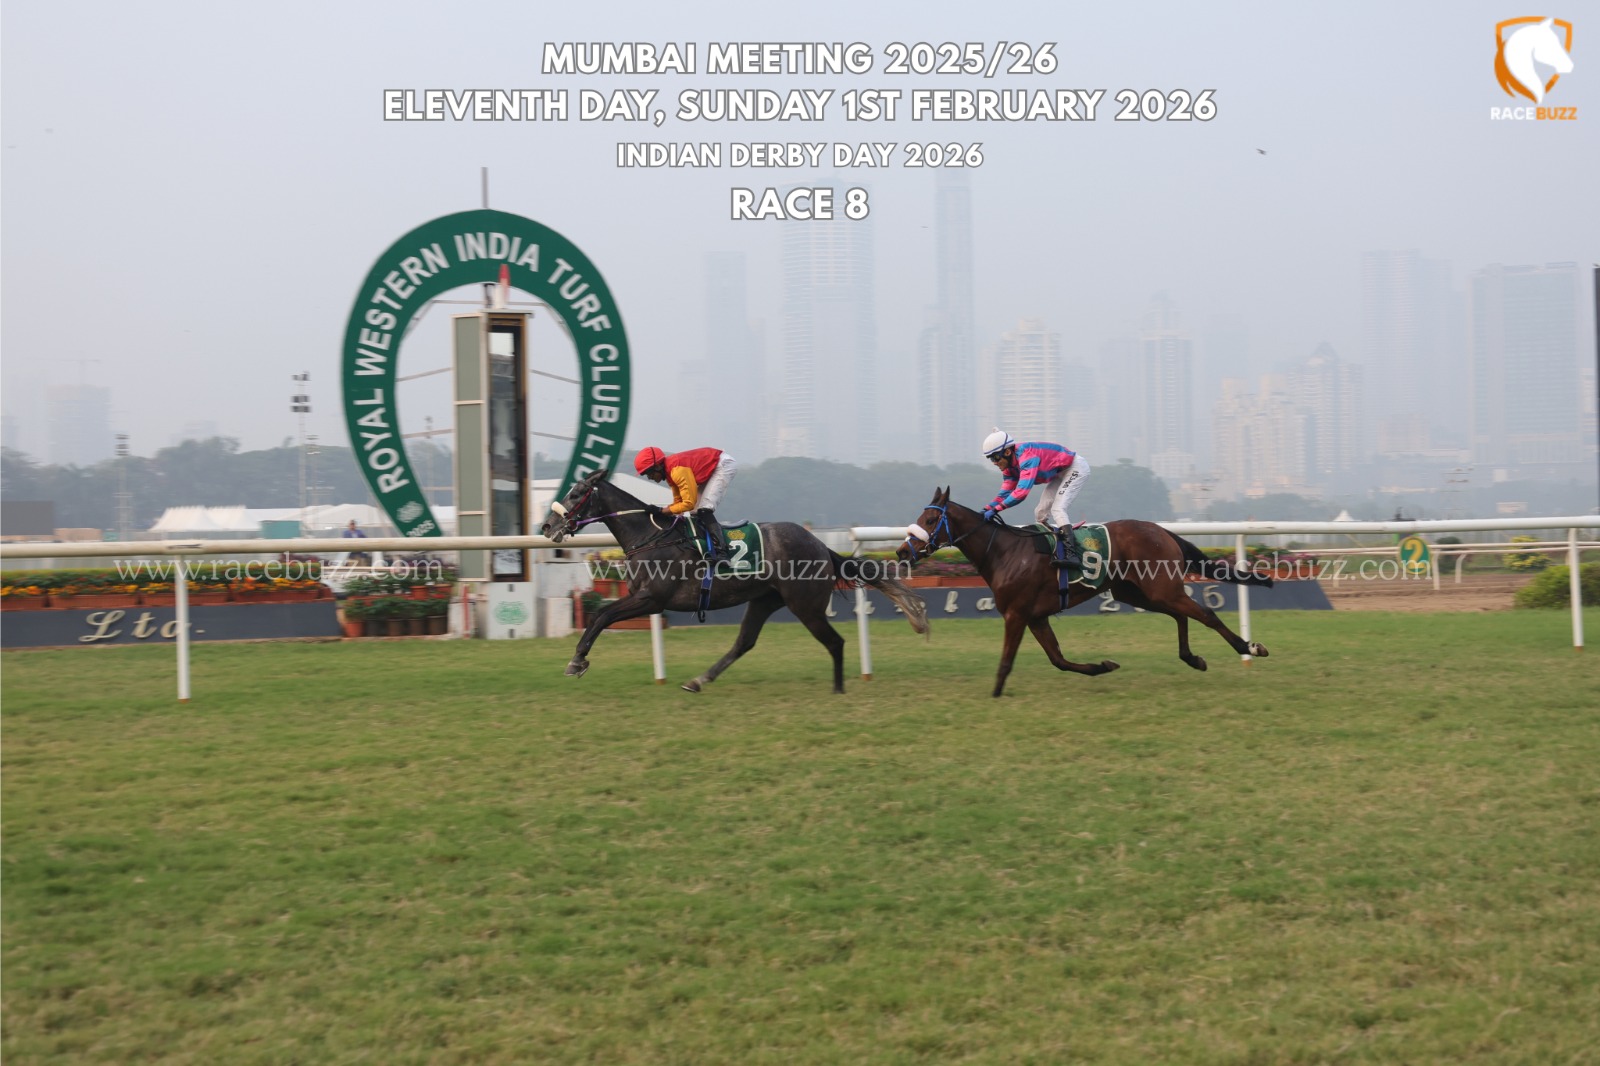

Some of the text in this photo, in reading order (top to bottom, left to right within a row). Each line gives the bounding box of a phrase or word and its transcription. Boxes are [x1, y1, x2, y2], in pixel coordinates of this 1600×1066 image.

[454, 232, 540, 273] INDIA
[354, 243, 450, 376] WESTERN
[548, 258, 612, 332] TURF
[353, 387, 410, 493] ROYAL
[728, 539, 749, 569] 2
[1082, 551, 1102, 580] 9
[1405, 539, 1425, 569] 2
